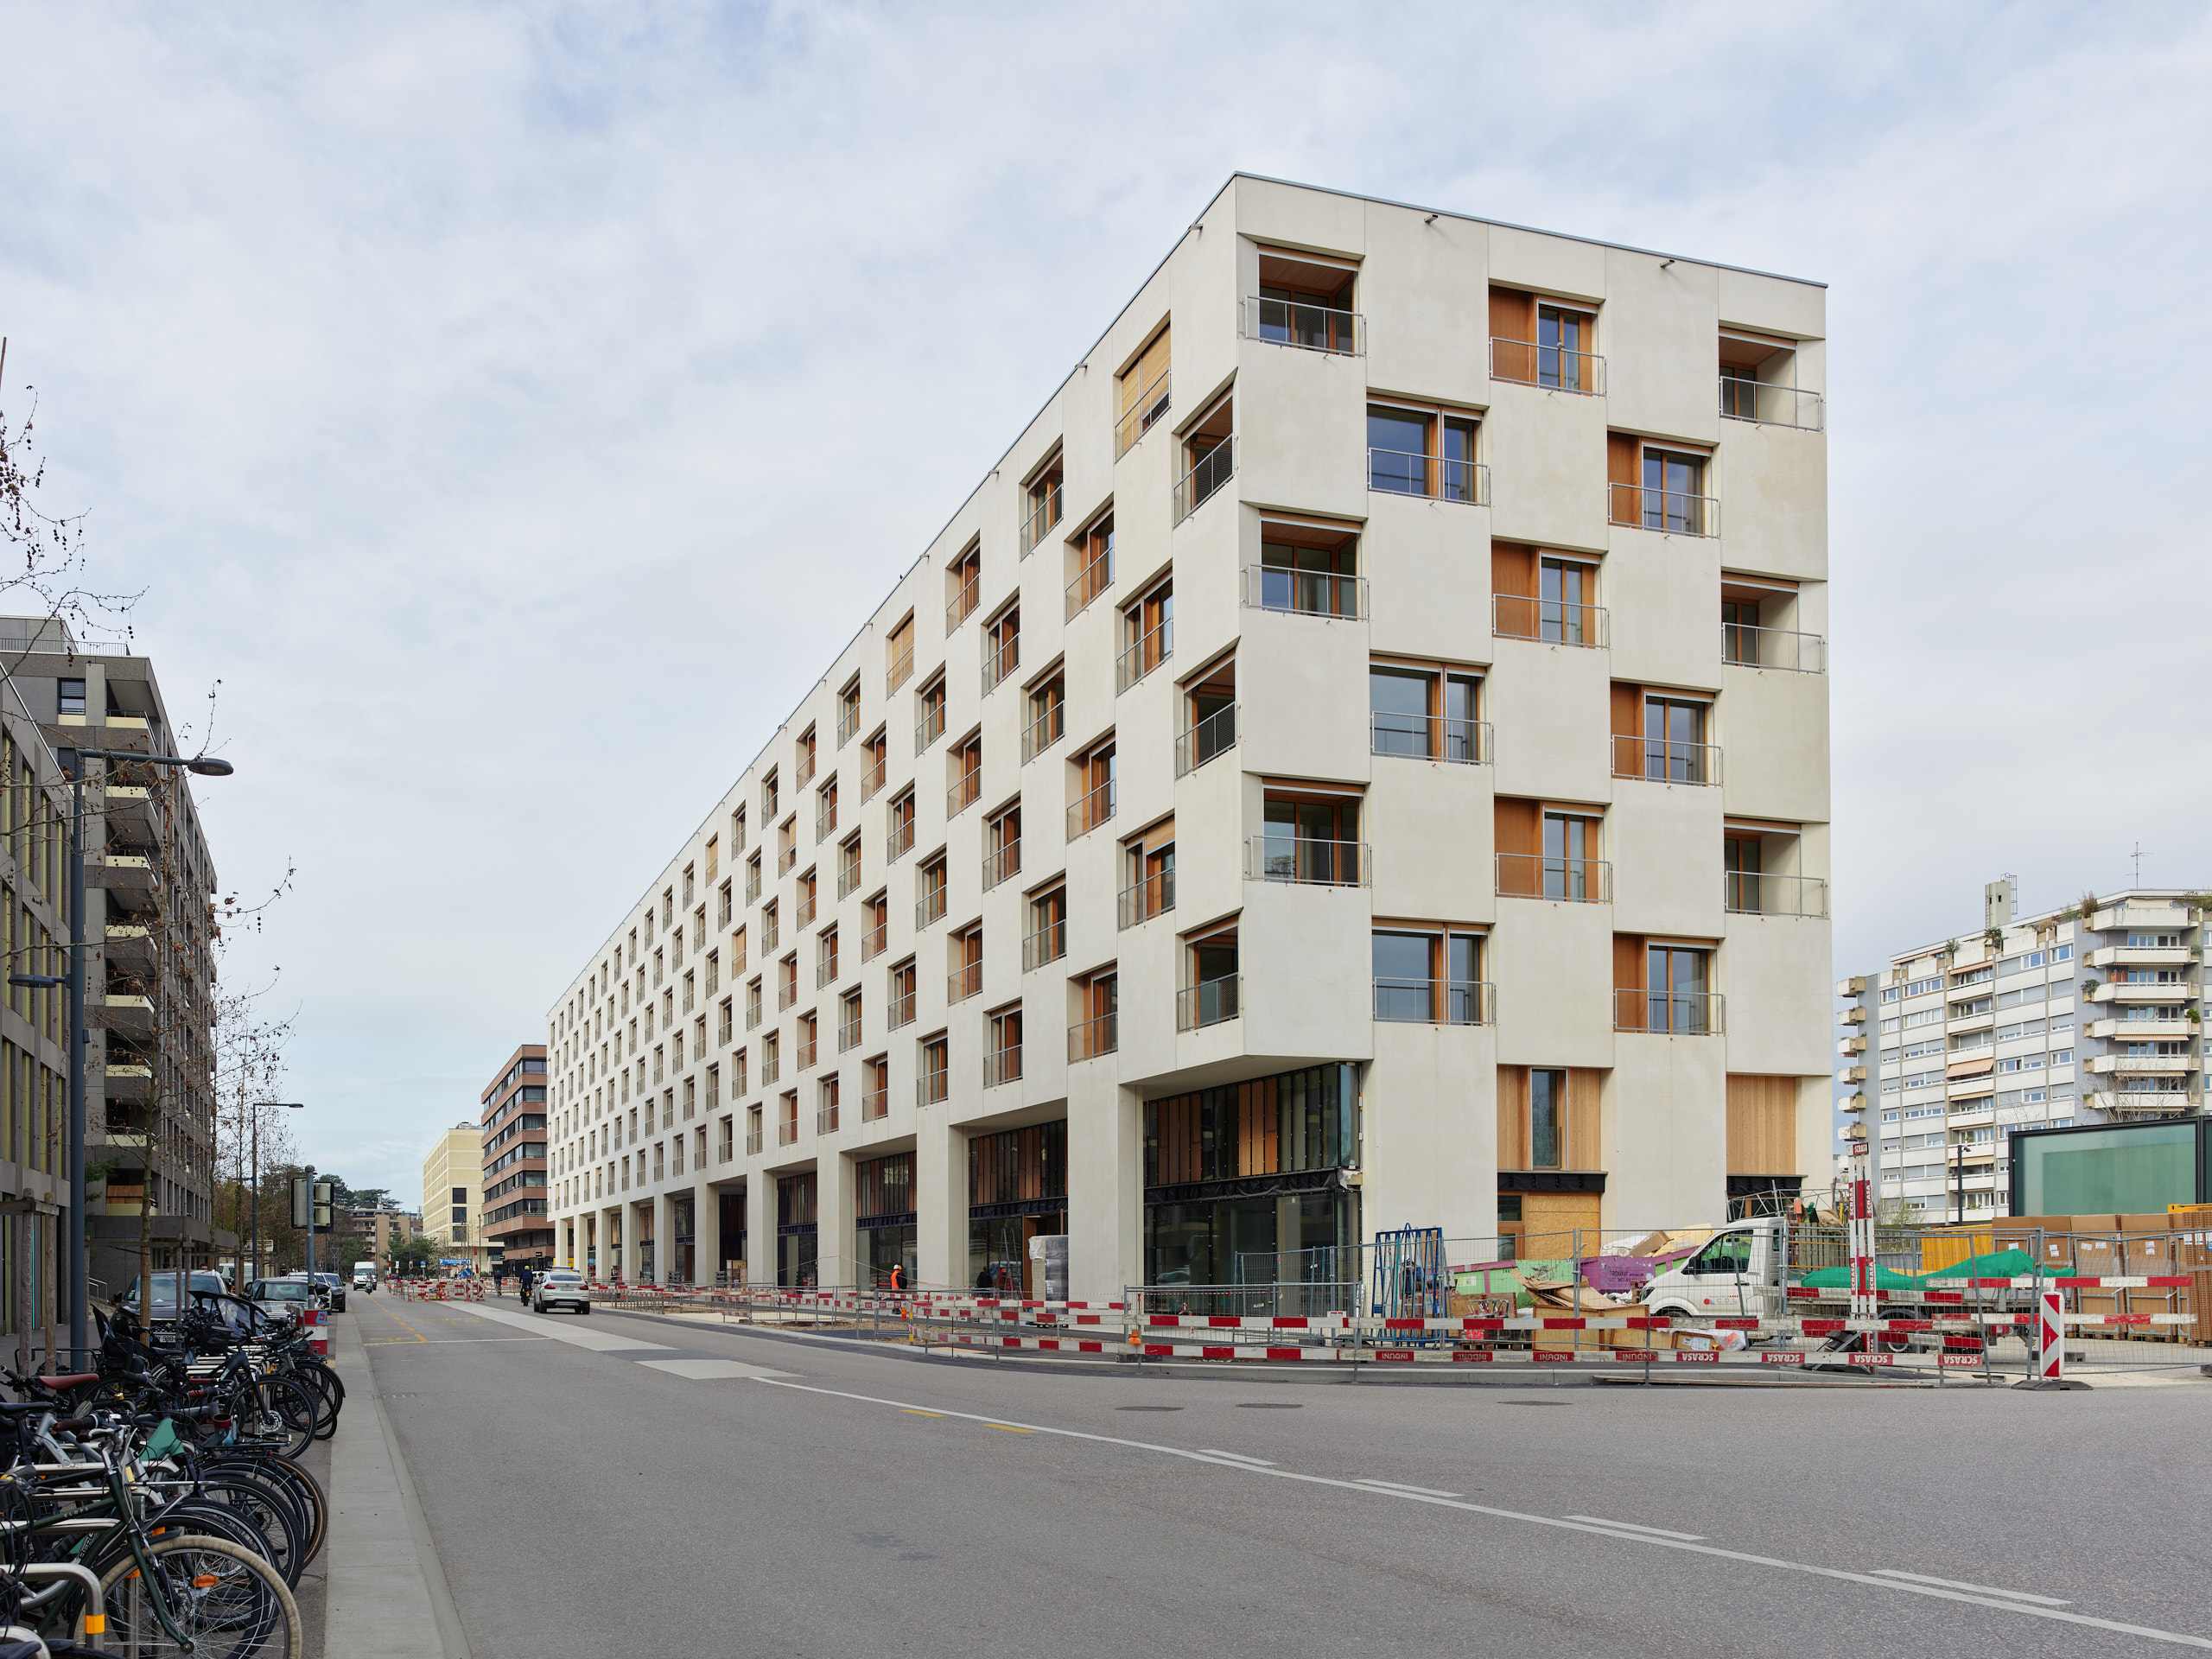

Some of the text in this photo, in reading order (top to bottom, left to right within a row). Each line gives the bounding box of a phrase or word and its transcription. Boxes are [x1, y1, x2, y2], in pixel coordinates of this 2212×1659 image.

[1681, 1352, 1714, 1361] SCRASA
[1766, 1353, 1800, 1363] SCRASA
[1854, 1354, 1888, 1363] SCRASA
[1943, 1355, 1978, 1364] SCRASA
[64, 1507, 89, 1518] ELOPS
